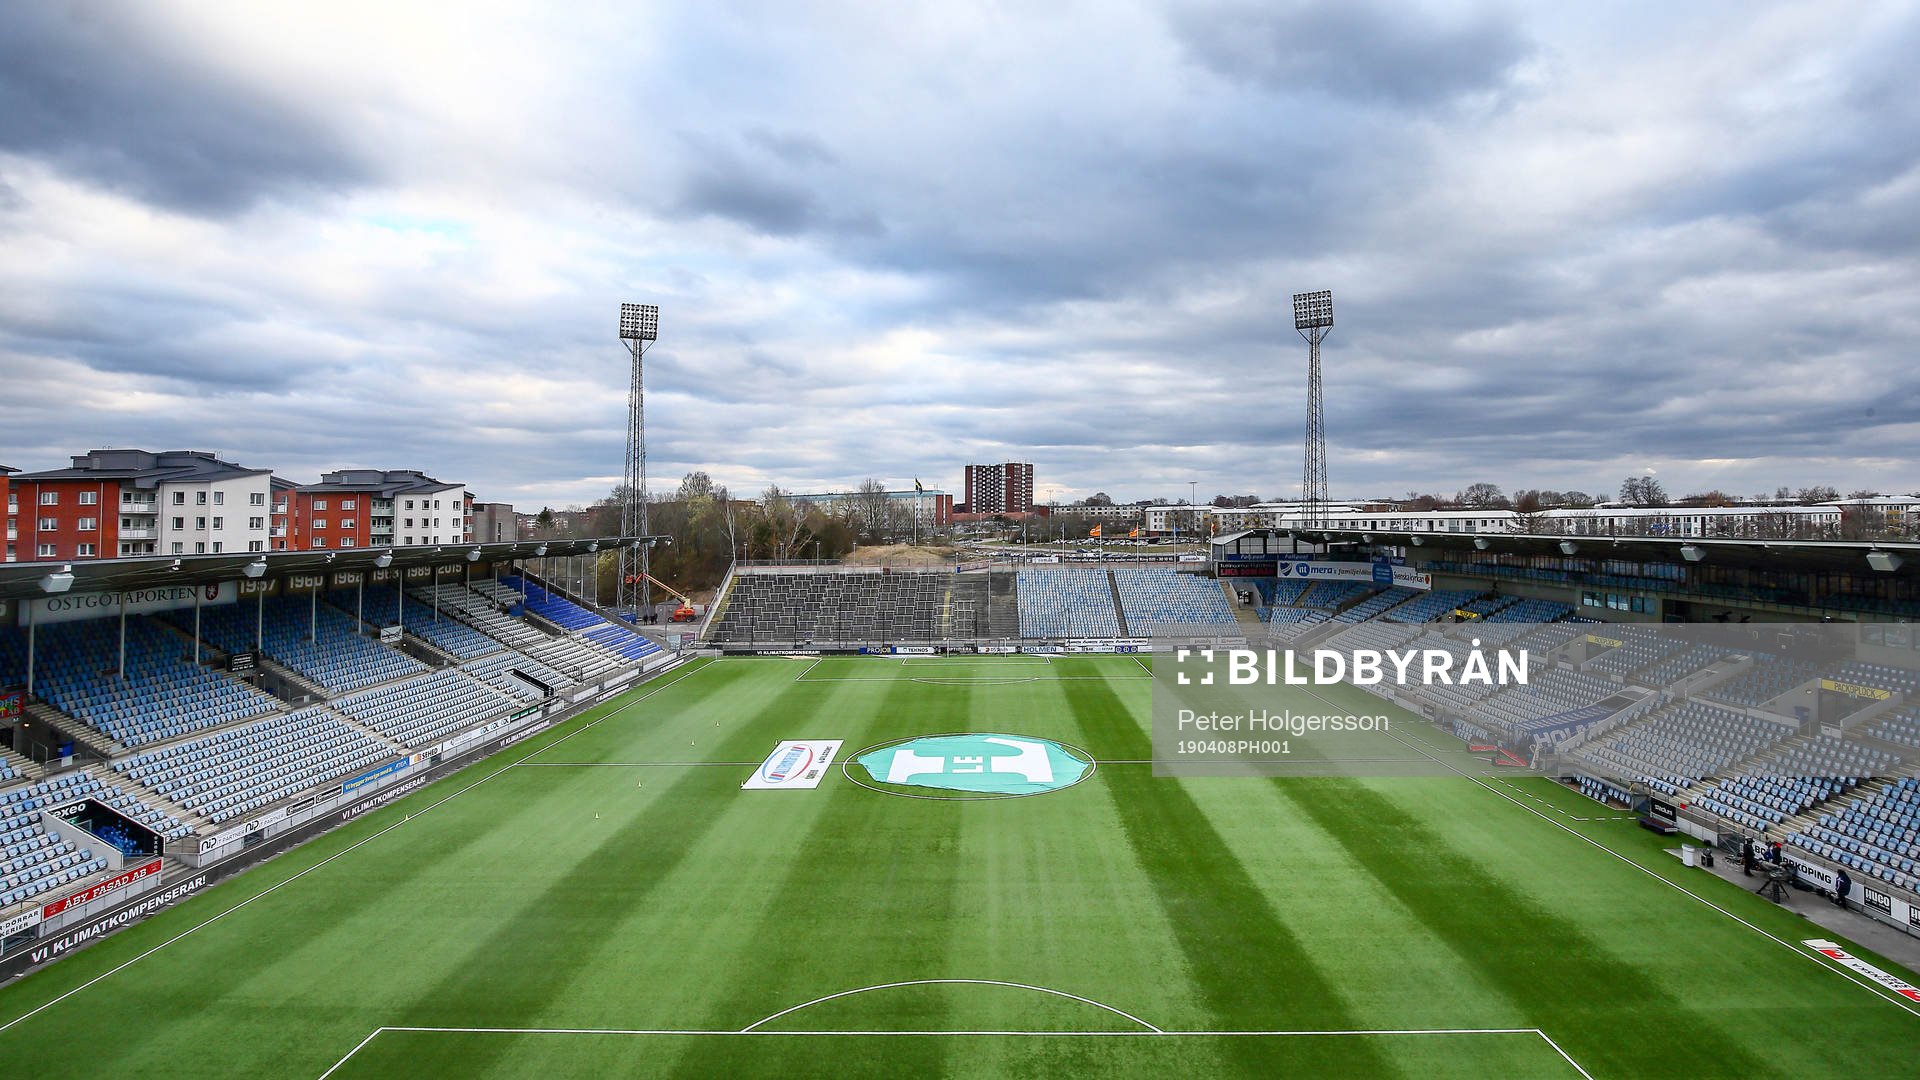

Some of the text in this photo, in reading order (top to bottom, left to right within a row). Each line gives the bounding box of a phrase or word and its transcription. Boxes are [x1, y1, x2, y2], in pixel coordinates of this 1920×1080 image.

[342, 809, 350, 820] VI
[351, 775, 426, 815] KLIMATKOMPENSERAR!
[93, 876, 129, 897] FASAD
[132, 868, 147, 881] AB
[31, 875, 206, 963] VI KLIMATKOMPENSERAR!
